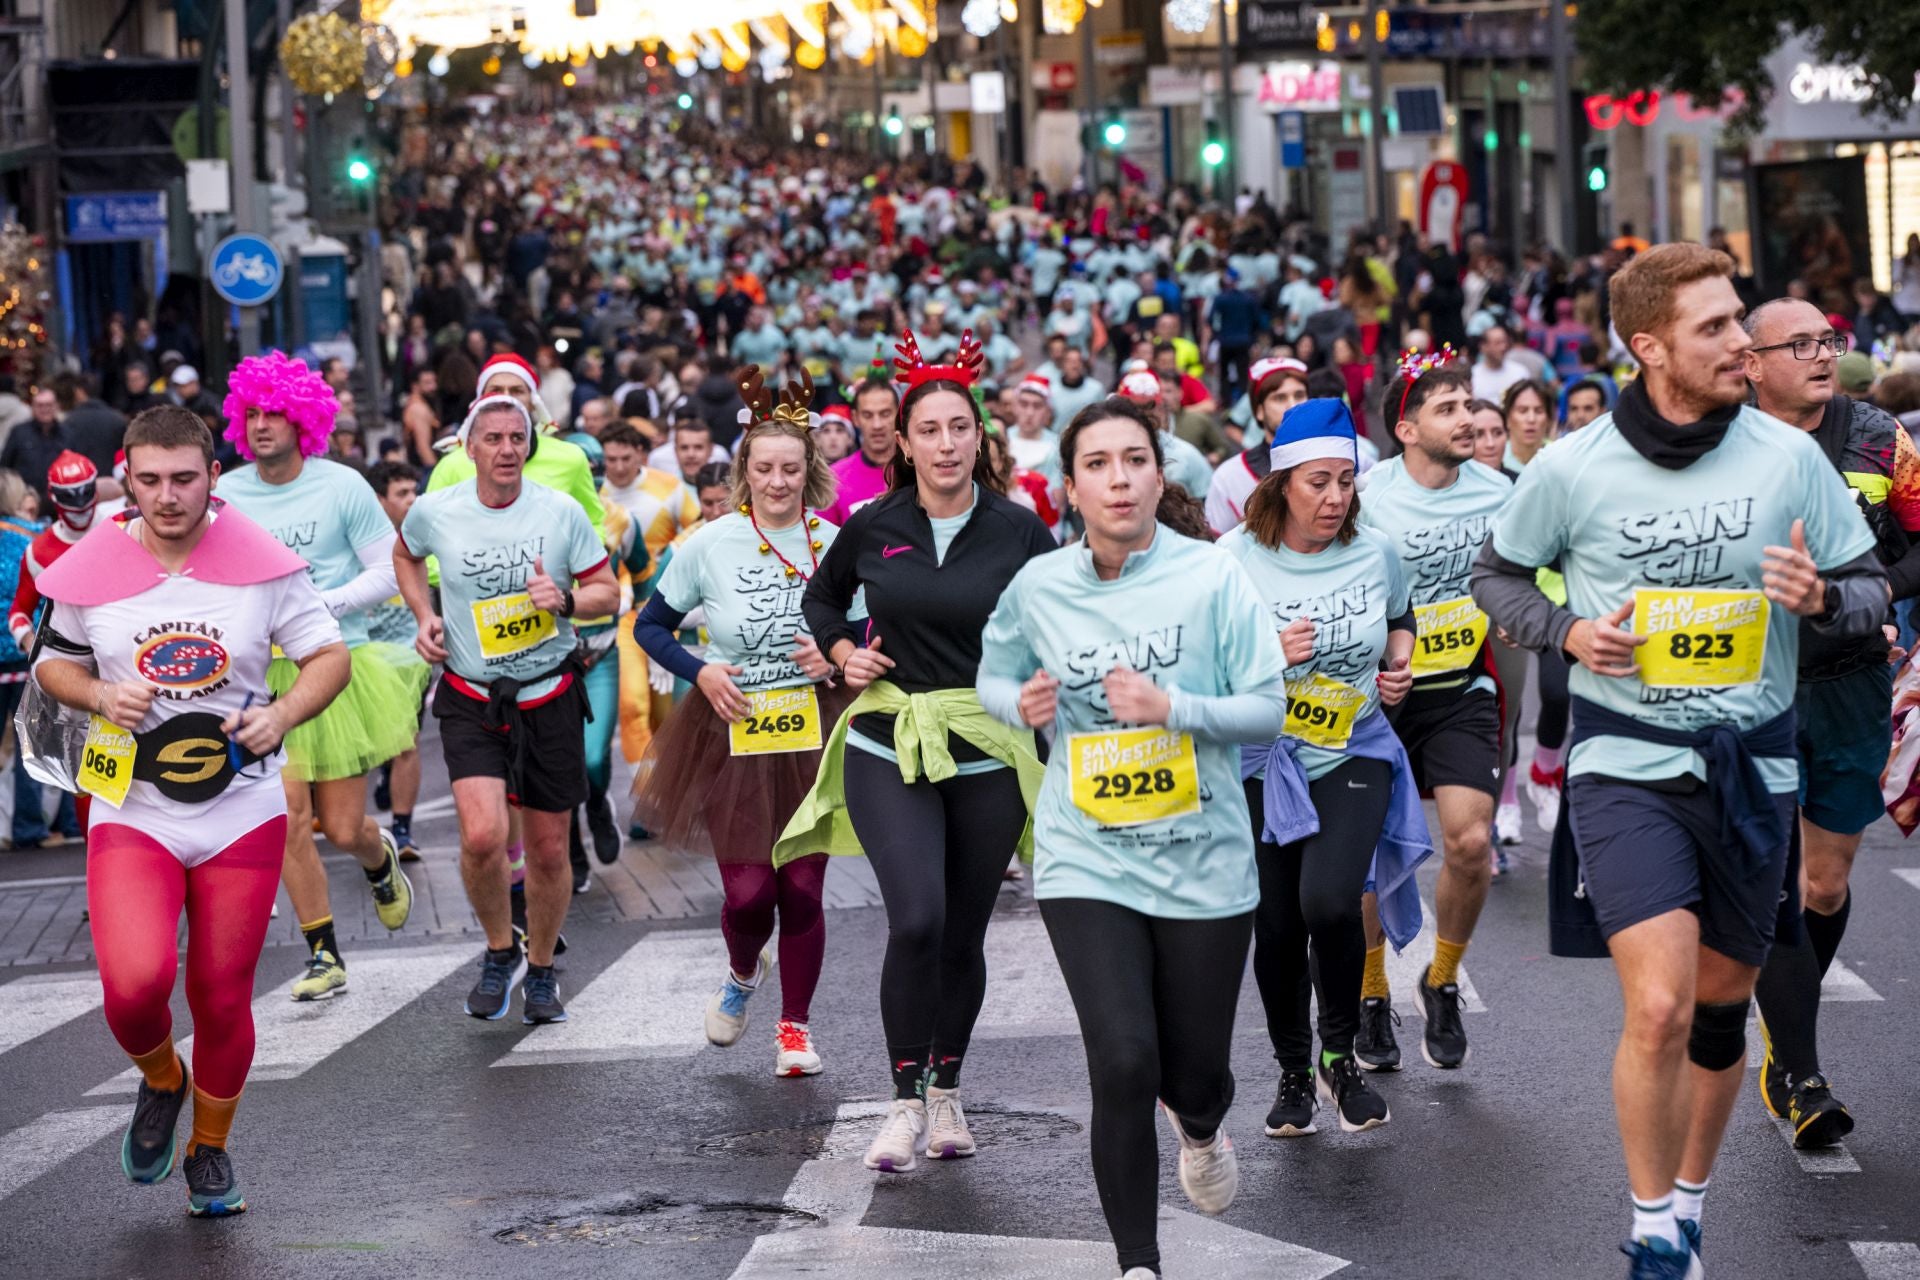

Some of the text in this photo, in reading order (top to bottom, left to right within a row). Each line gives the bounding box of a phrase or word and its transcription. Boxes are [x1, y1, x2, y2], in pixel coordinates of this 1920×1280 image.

[274, 521, 317, 548] AN
[1403, 515, 1486, 562] SAN
[1616, 497, 1753, 559] SAN
[461, 536, 543, 576] SAN
[1646, 597, 1761, 635] SILVESTRE
[1648, 595, 1694, 617] SAN
[133, 621, 224, 645] CAPITÁN
[493, 613, 541, 640] 2671
[1420, 629, 1476, 654] 1358
[1669, 633, 1734, 659] 823
[746, 689, 809, 717] ILVESTRE
[747, 691, 767, 706] AN
[744, 714, 806, 736] 2469
[1286, 696, 1339, 730] 1091
[1081, 736, 1120, 761] SAN
[1081, 730, 1182, 778] SILVESTRE
[1092, 768, 1176, 800] 2928
